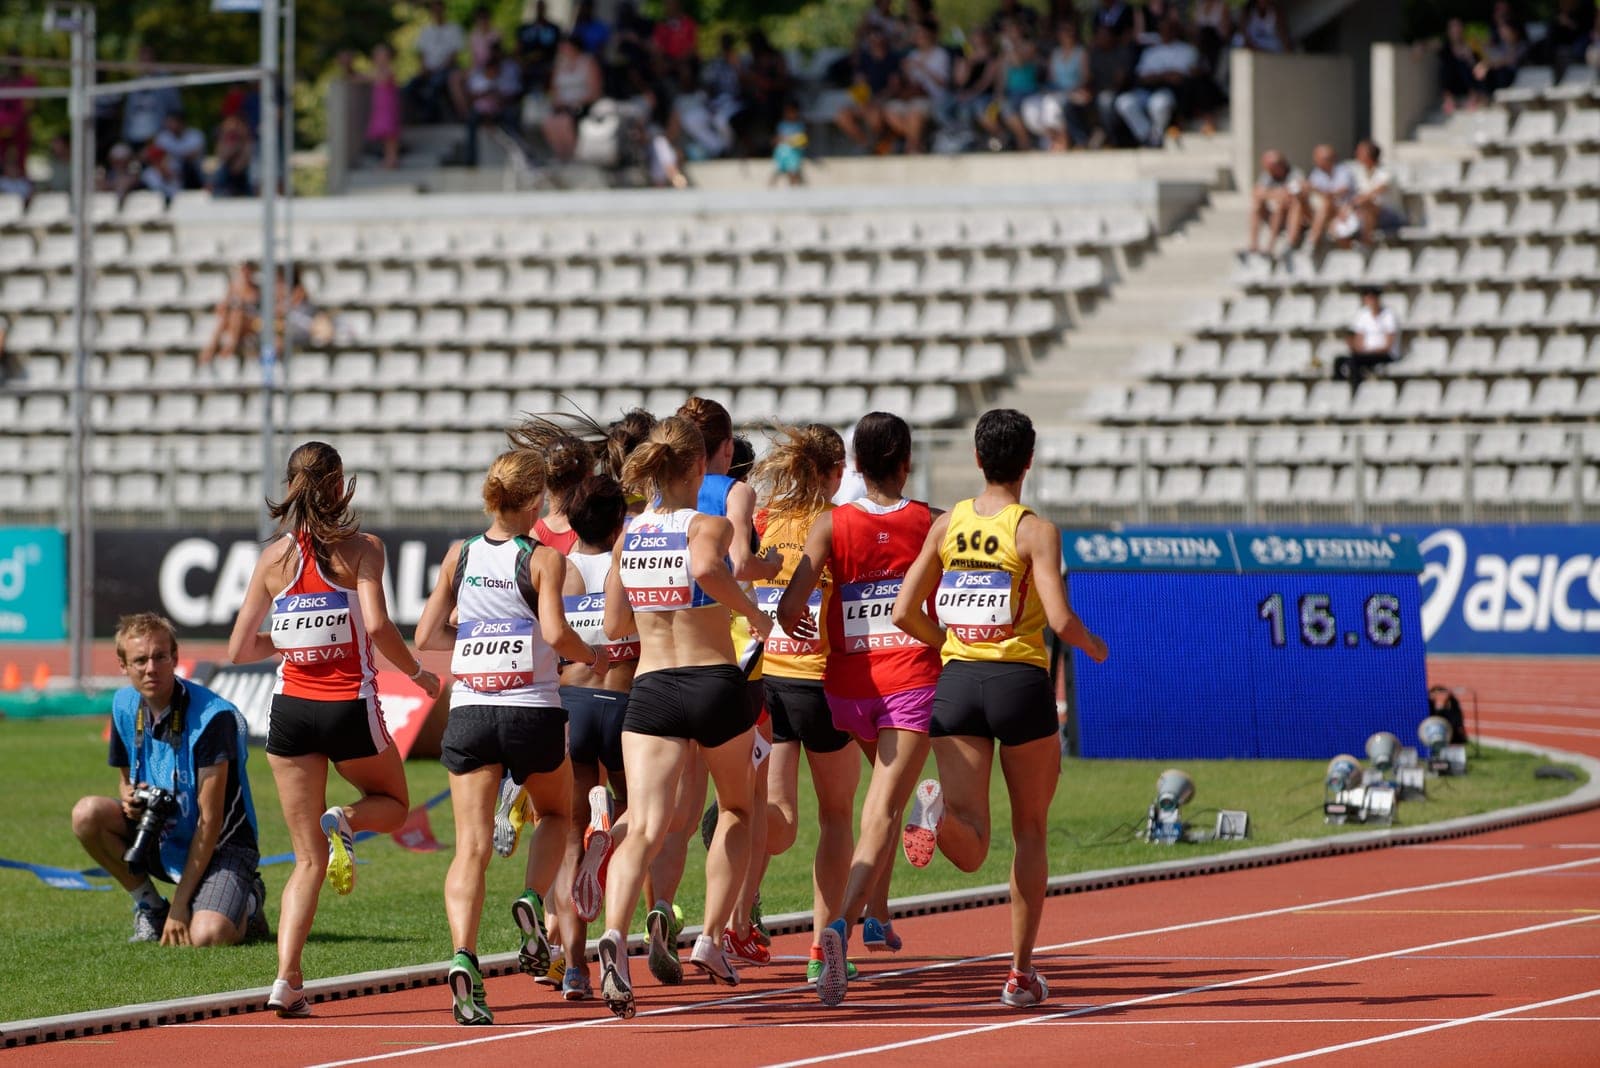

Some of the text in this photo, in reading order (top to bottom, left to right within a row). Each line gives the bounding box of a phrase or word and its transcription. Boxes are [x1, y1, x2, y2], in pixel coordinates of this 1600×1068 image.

[641, 536, 668, 548] asics
[1129, 537, 1221, 558] FESTINA
[1303, 538, 1395, 560] FESTINA
[482, 577, 513, 590] Tassin
[668, 576, 674, 586] 8
[969, 575, 992, 586] asics
[299, 597, 327, 608] asics
[628, 591, 682, 603] AREVA
[939, 594, 1008, 608] DIFFERT
[274, 613, 348, 631] LE FLOCH
[991, 614, 996, 623] 4
[483, 623, 512, 634] asics
[331, 633, 337, 642] 6
[462, 640, 524, 657] GOURS
[282, 648, 345, 662] AREVA
[511, 661, 517, 670] 5
[461, 675, 525, 688] AREVA
